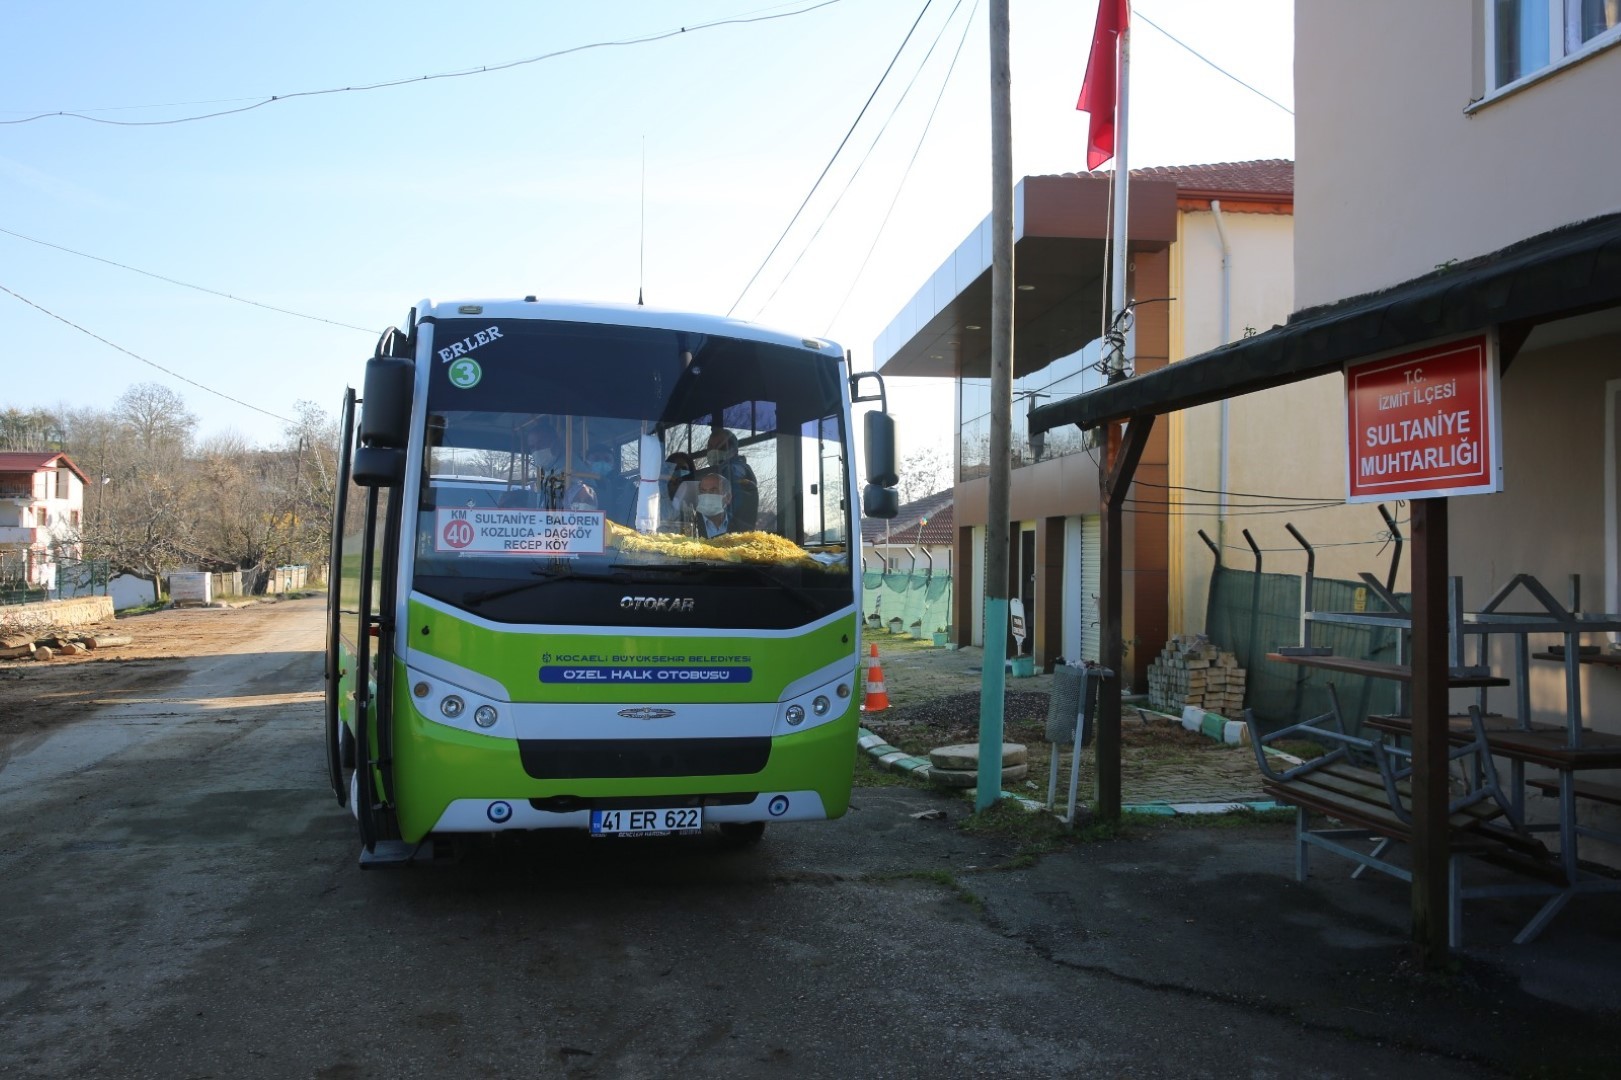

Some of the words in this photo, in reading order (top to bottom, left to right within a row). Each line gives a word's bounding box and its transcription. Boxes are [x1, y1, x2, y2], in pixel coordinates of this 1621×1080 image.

[438, 326, 503, 363] ERLER
[455, 362, 476, 385] 3
[1404, 368, 1426, 385] T.C.
[1379, 389, 1410, 411] İZMİT
[1413, 379, 1456, 405] İLÇESİ
[1366, 410, 1470, 447] SULTANİYE
[1361, 437, 1478, 477] MUHTARLIĞI
[451, 510, 467, 520] KM
[475, 512, 536, 525] SULTANİYE
[546, 513, 599, 526] BALÖREN
[446, 524, 471, 544] 40
[481, 527, 535, 538] KOZLUCA
[544, 526, 592, 539] DAĞKÖY
[504, 540, 542, 550] RECEP
[545, 538, 569, 550] KÖY
[620, 595, 694, 612] OTOKAR
[563, 669, 607, 679] ÖZEL
[611, 670, 653, 679] HALK
[657, 670, 729, 680] OTOBÜSÜ
[602, 811, 620, 830] 41
[630, 810, 657, 829] ER
[665, 809, 698, 828] 622
